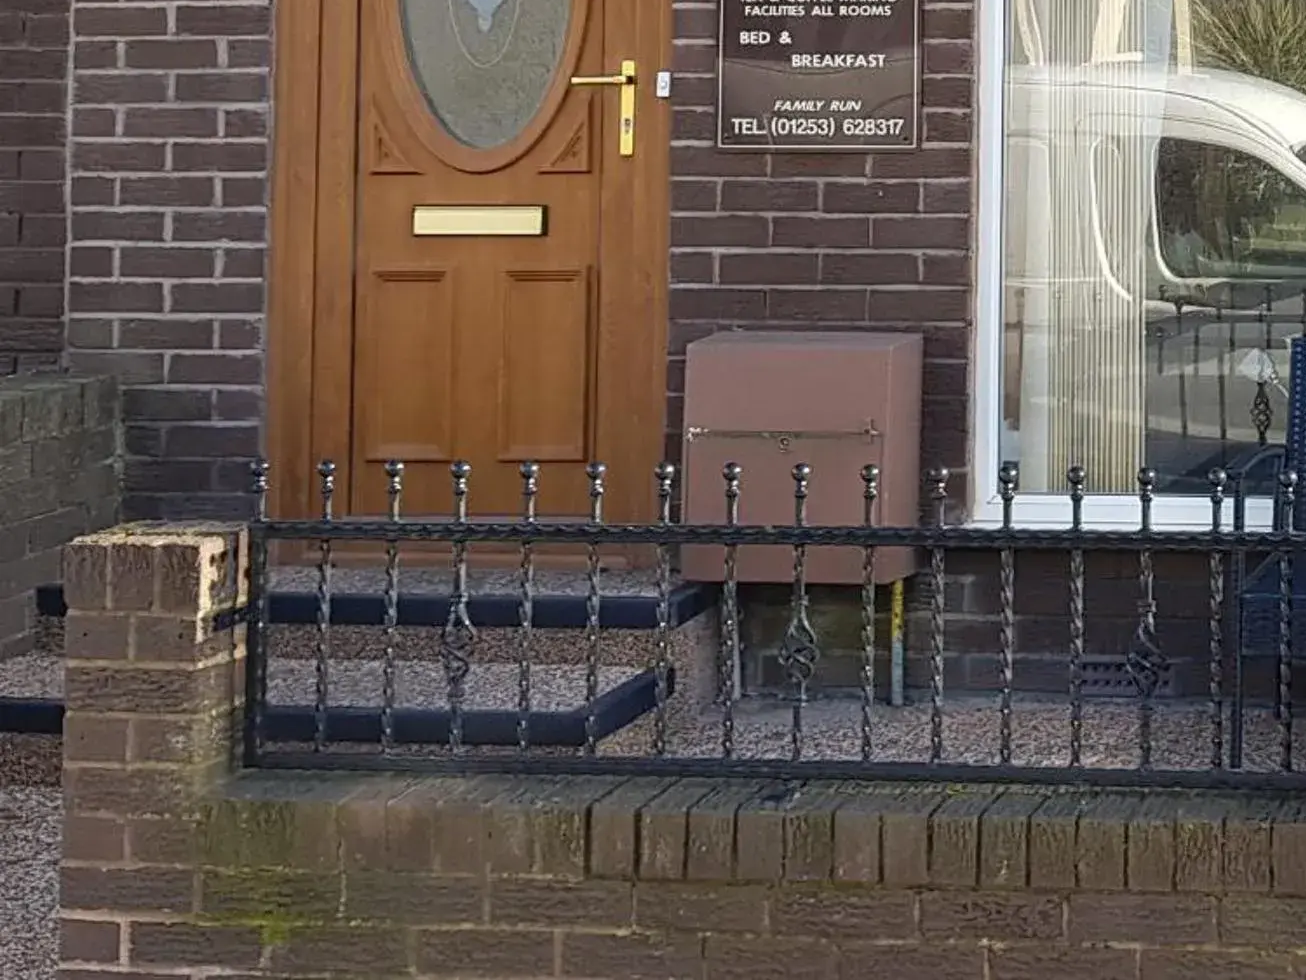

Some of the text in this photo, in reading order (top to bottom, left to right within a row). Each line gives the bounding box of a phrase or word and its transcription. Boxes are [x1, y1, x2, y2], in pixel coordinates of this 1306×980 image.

[745, 5, 891, 17] FACILITIES ALL ROOMS
[740, 31, 791, 44] BED &
[792, 54, 885, 68] BREAKFAST
[774, 100, 861, 111] FAMILY RUN
[771, 117, 835, 137] (01253)
[843, 119, 904, 135] 628317
